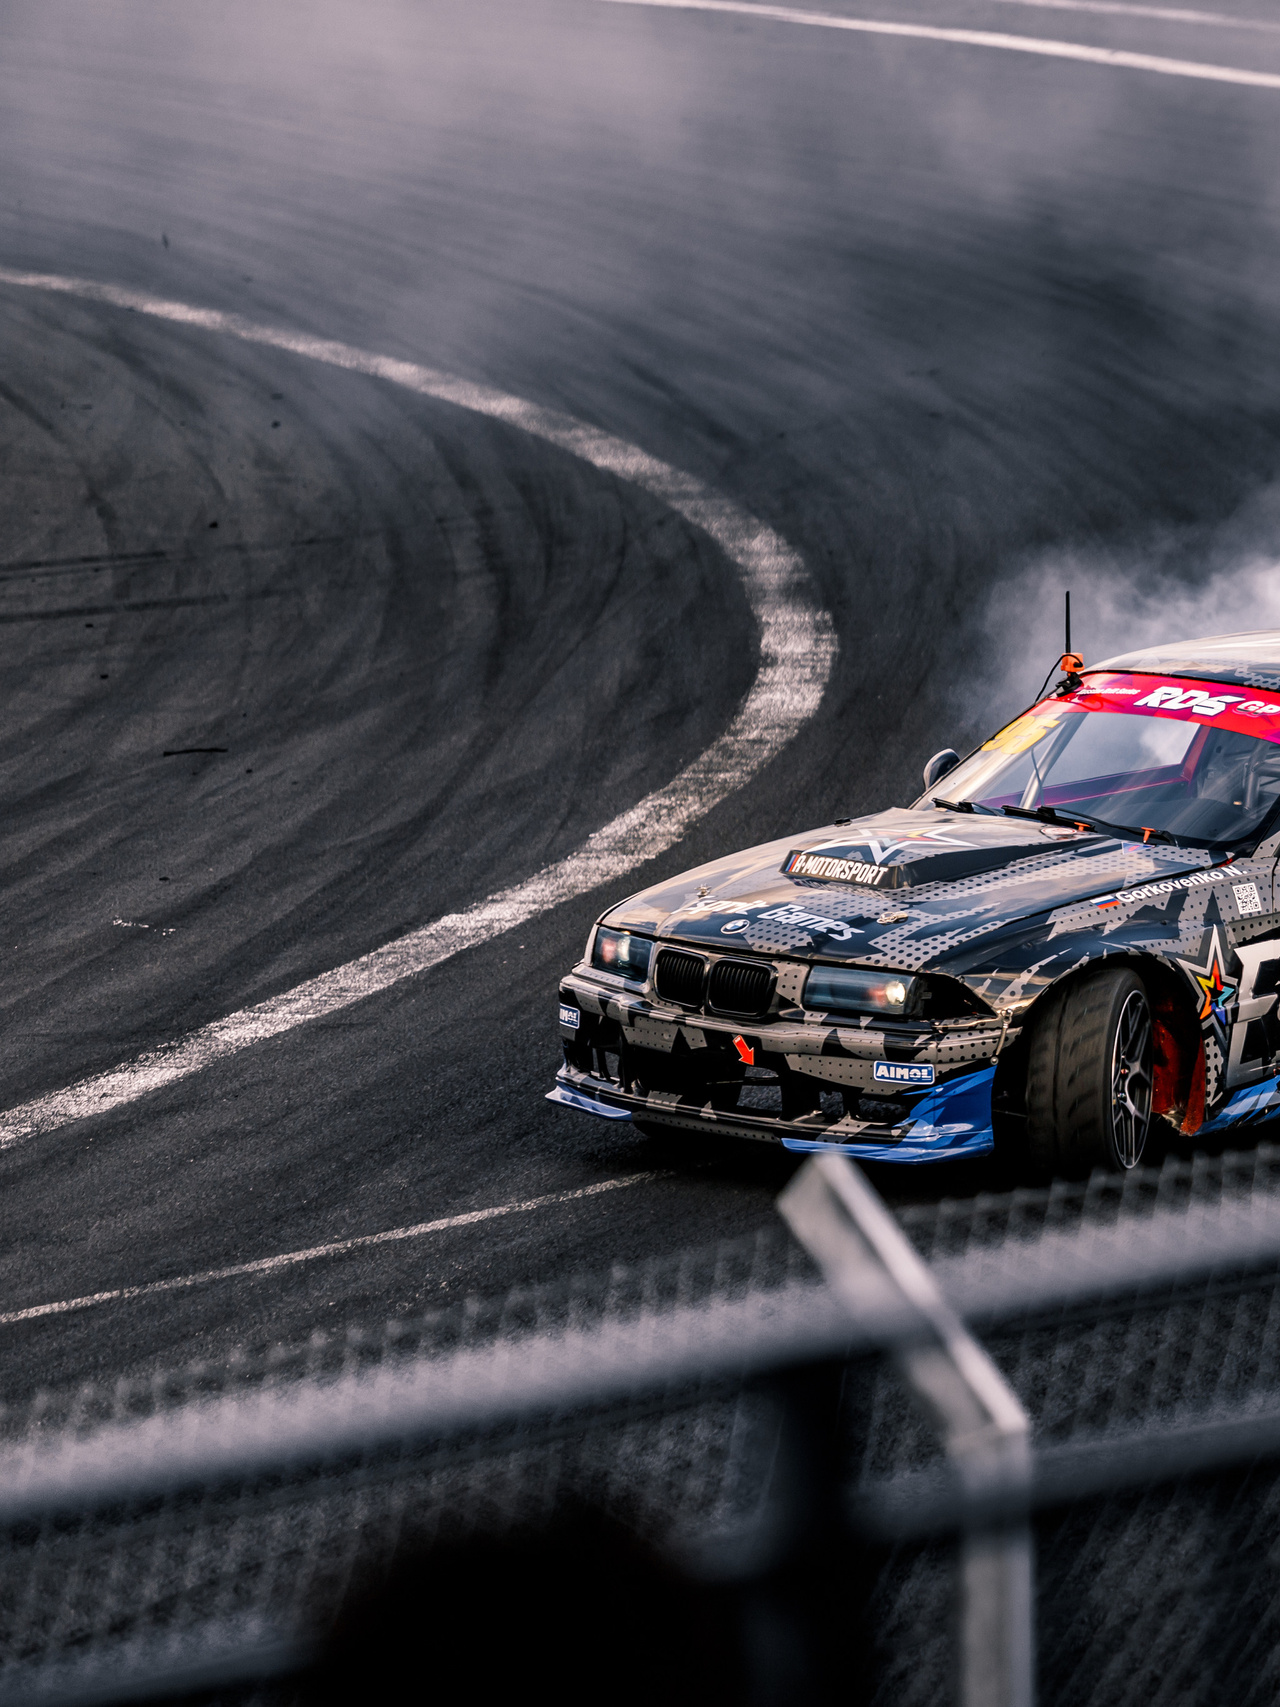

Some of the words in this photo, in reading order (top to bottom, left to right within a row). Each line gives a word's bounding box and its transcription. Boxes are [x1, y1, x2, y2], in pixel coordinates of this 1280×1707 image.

[1133, 686, 1246, 716] RDS
[1115, 868, 1225, 903] Gorkovenko
[1222, 865, 1248, 877] N.
[876, 1065, 932, 1081] AIMOL
